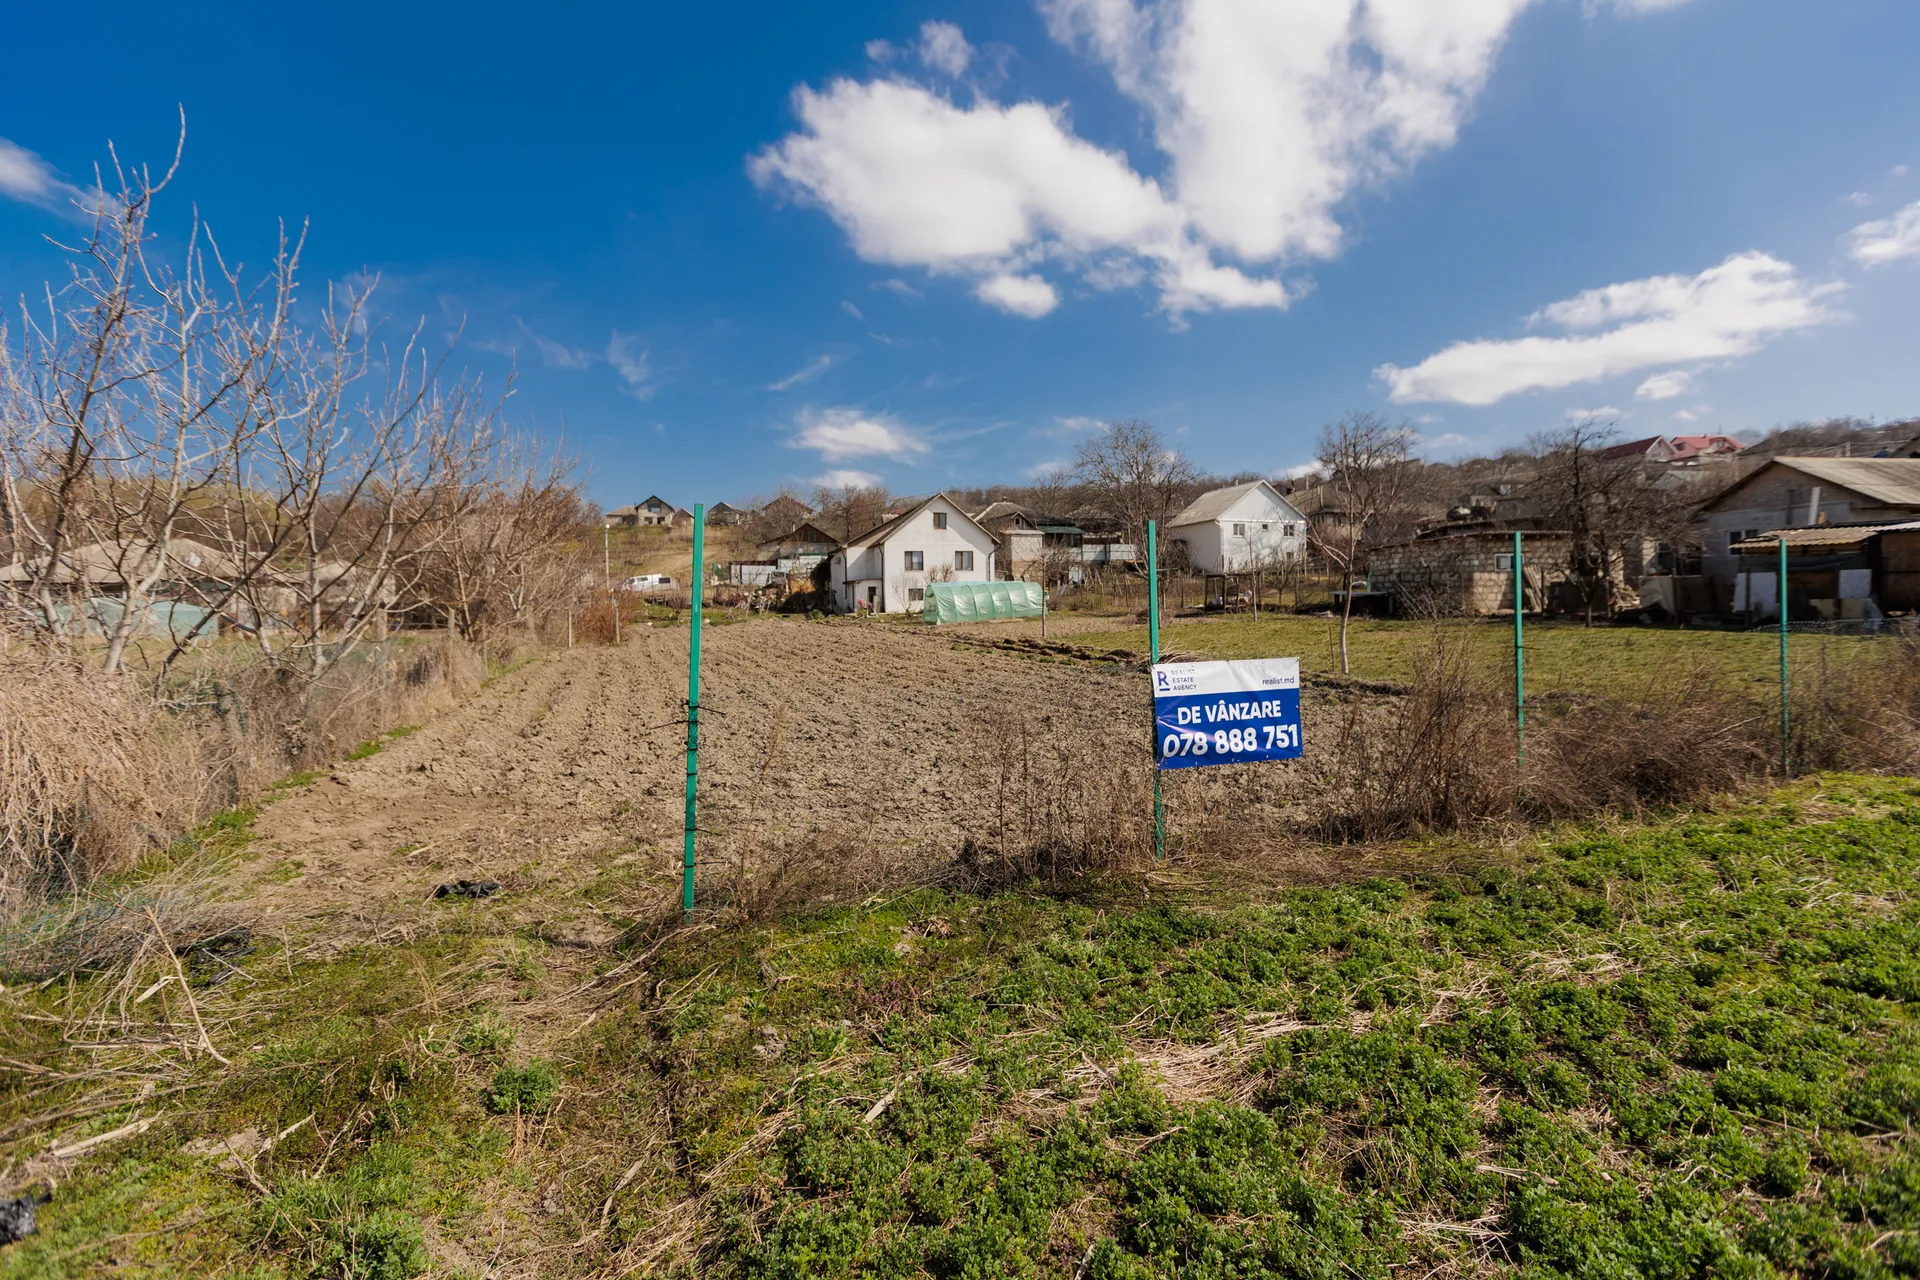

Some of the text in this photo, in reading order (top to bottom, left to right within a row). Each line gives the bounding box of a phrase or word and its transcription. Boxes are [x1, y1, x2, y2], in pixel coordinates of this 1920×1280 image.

[1157, 671, 1169, 686] R
[1262, 676, 1294, 685] realist.md
[1177, 700, 1281, 725] DE VÂNZARE
[1163, 723, 1298, 758] 078 888 751
